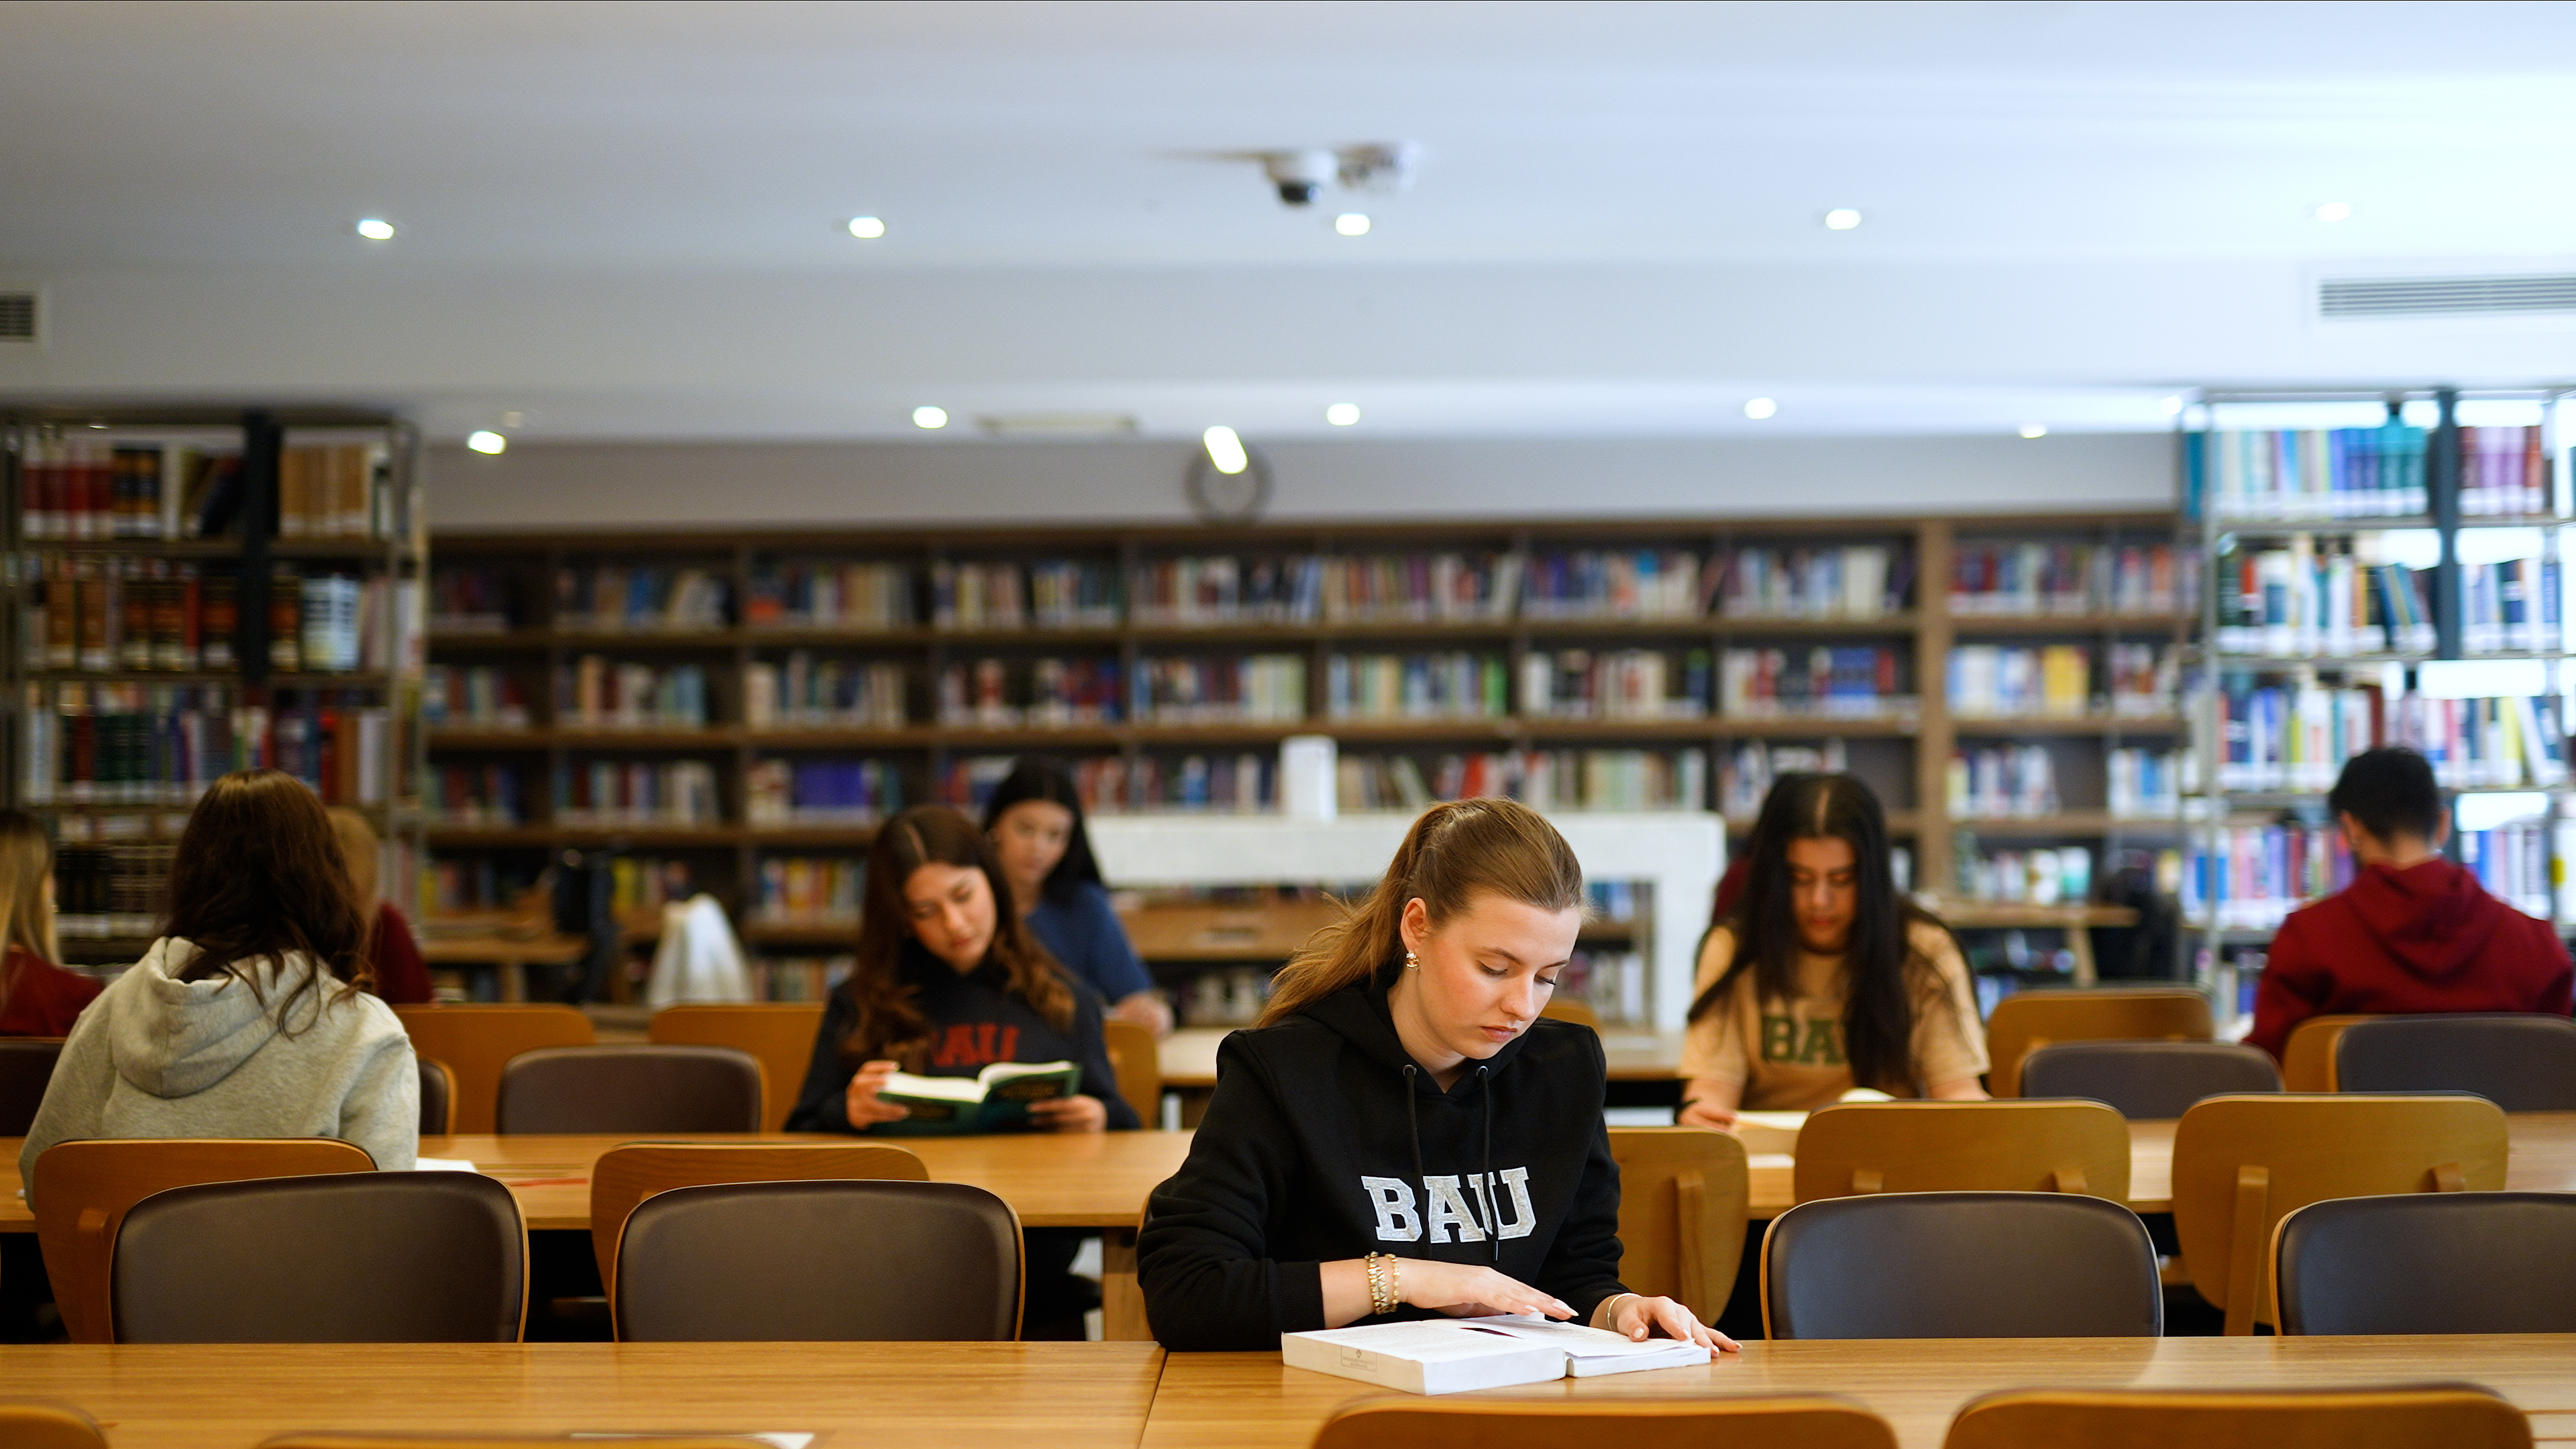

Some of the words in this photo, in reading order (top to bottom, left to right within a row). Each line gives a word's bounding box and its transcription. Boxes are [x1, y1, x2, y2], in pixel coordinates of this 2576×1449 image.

[930, 1023, 1019, 1067] AU
[1762, 1016, 1845, 1065] BA
[1361, 1166, 1536, 1244] BAU
